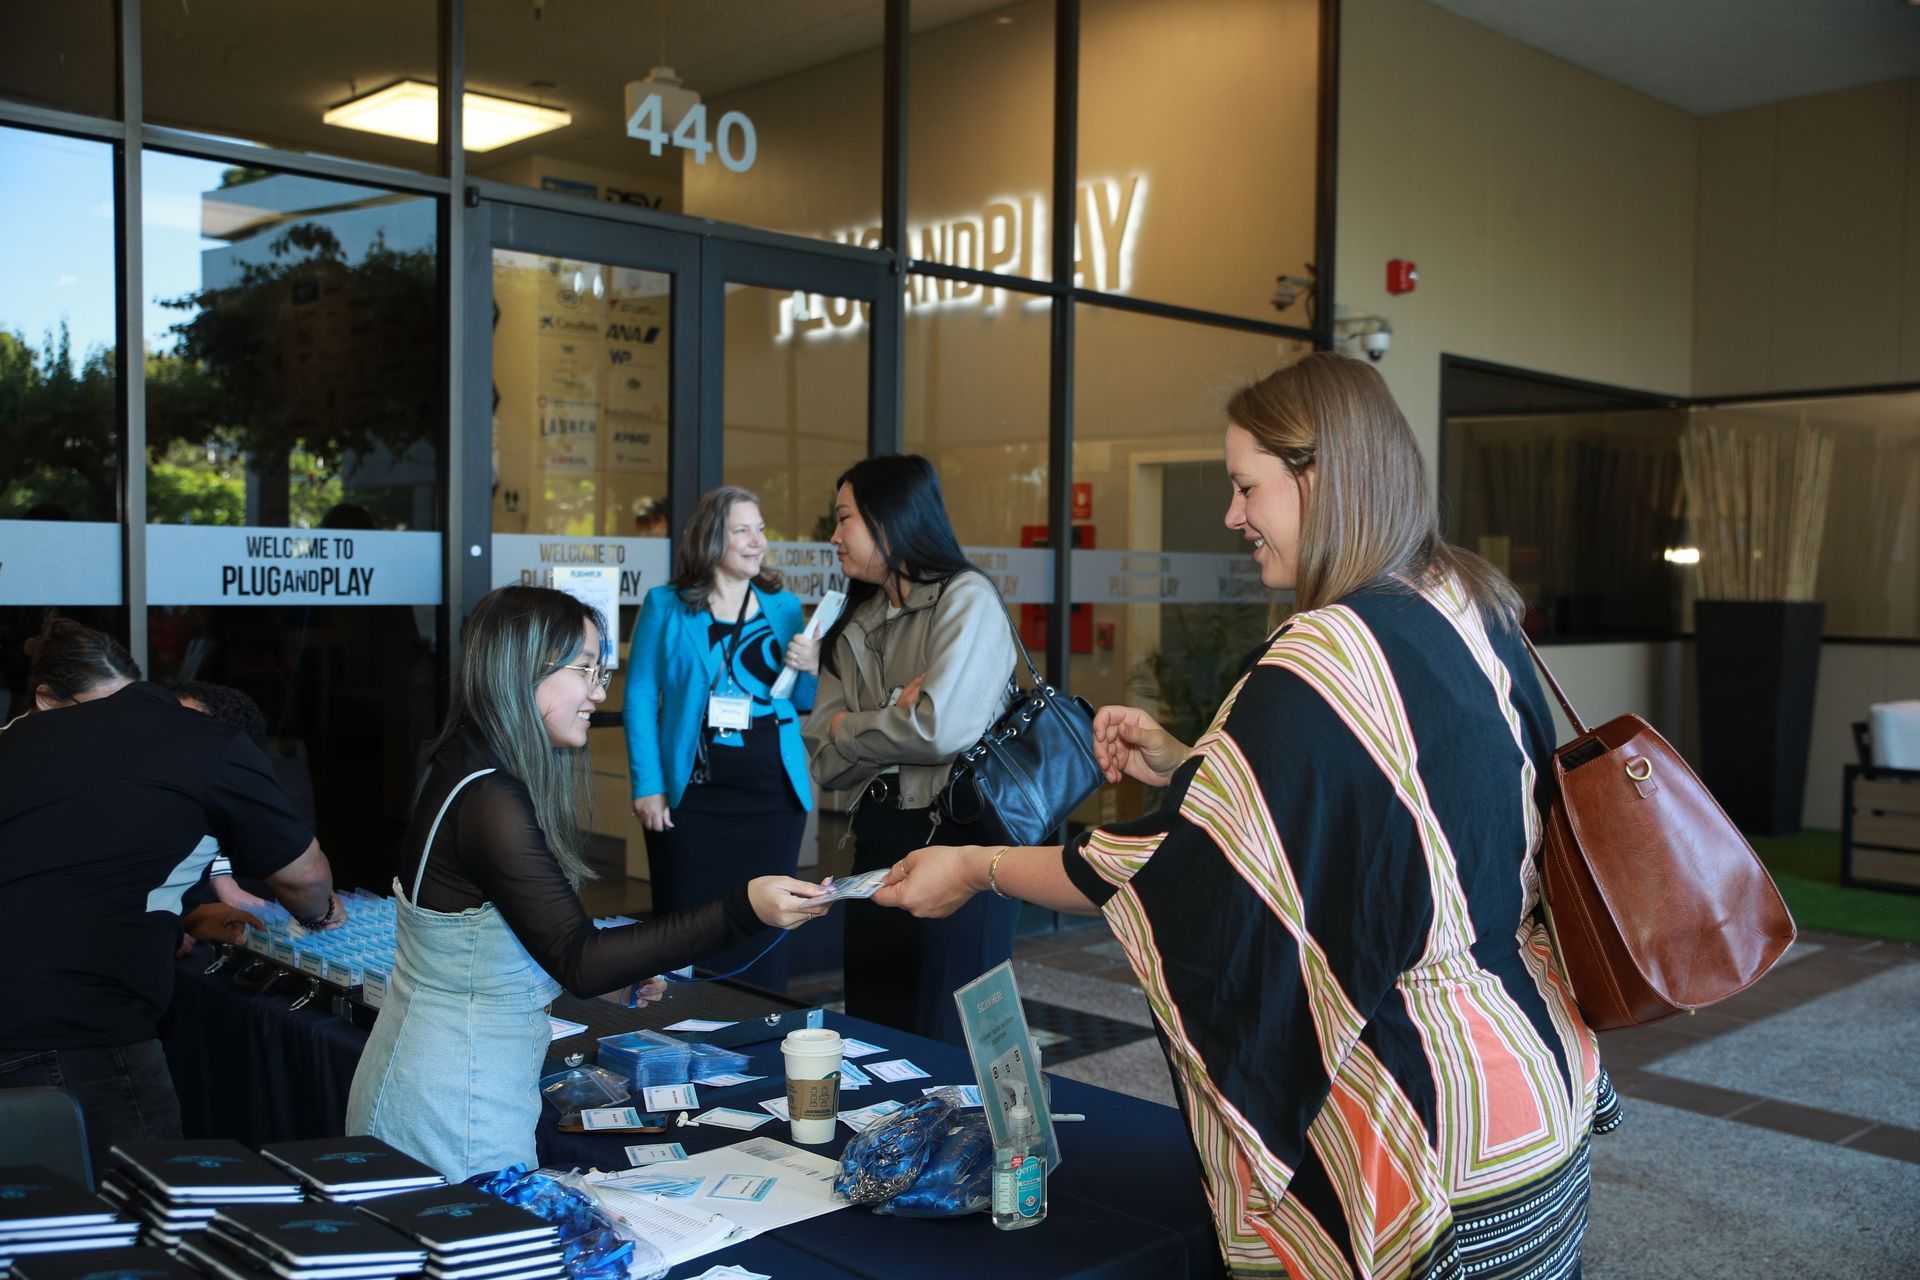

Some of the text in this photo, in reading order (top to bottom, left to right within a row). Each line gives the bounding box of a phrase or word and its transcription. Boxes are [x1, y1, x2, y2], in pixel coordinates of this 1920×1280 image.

[627, 93, 757, 173] 440
[606, 324, 643, 343] ANA
[246, 536, 354, 559] WELCOME TO
[539, 543, 626, 564] WELCOME TO
[819, 549, 833, 567] TO
[222, 566, 374, 596] PLUGANDPLAY
